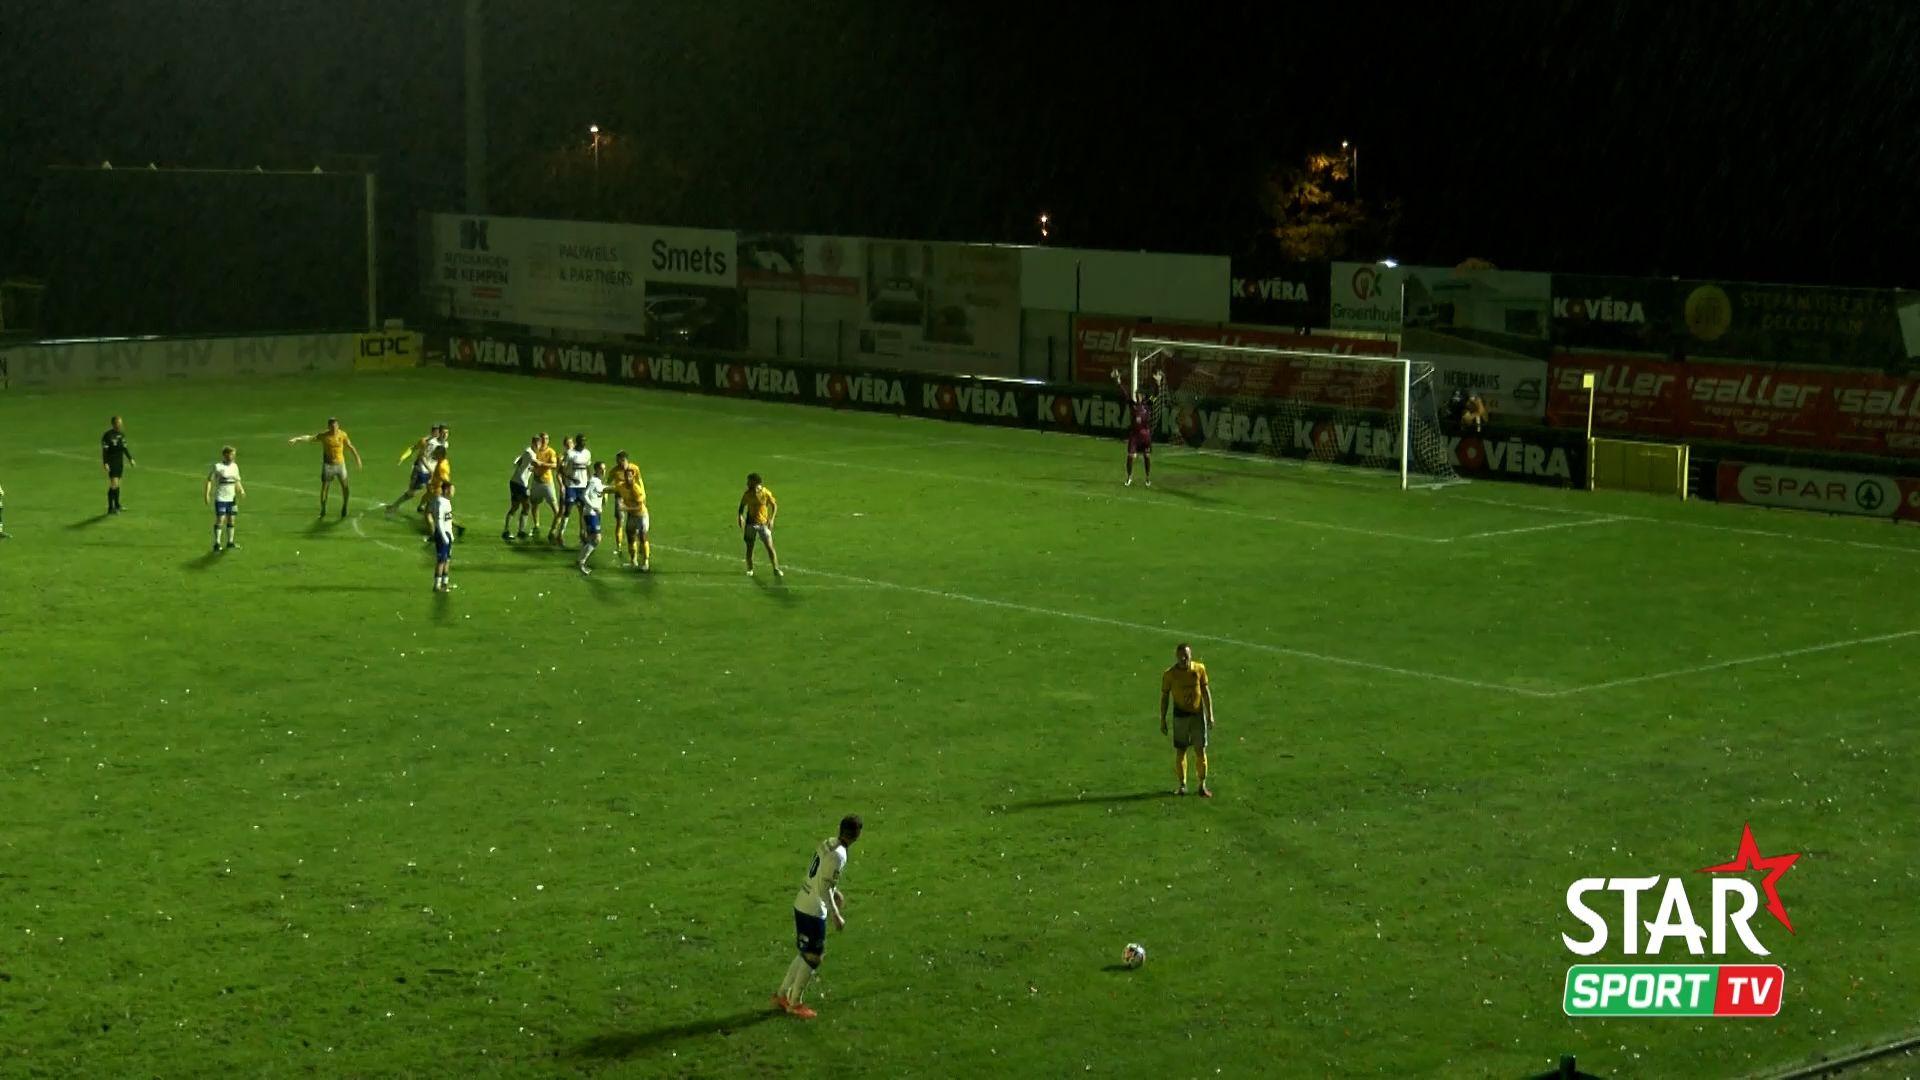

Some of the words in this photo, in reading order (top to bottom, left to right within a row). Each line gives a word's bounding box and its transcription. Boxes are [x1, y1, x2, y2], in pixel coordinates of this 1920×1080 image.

[651, 238, 726, 277] Smets
[569, 270, 632, 287] PARTNERS
[360, 336, 408, 358] ICPC
[1752, 475, 1847, 503] SPAR
